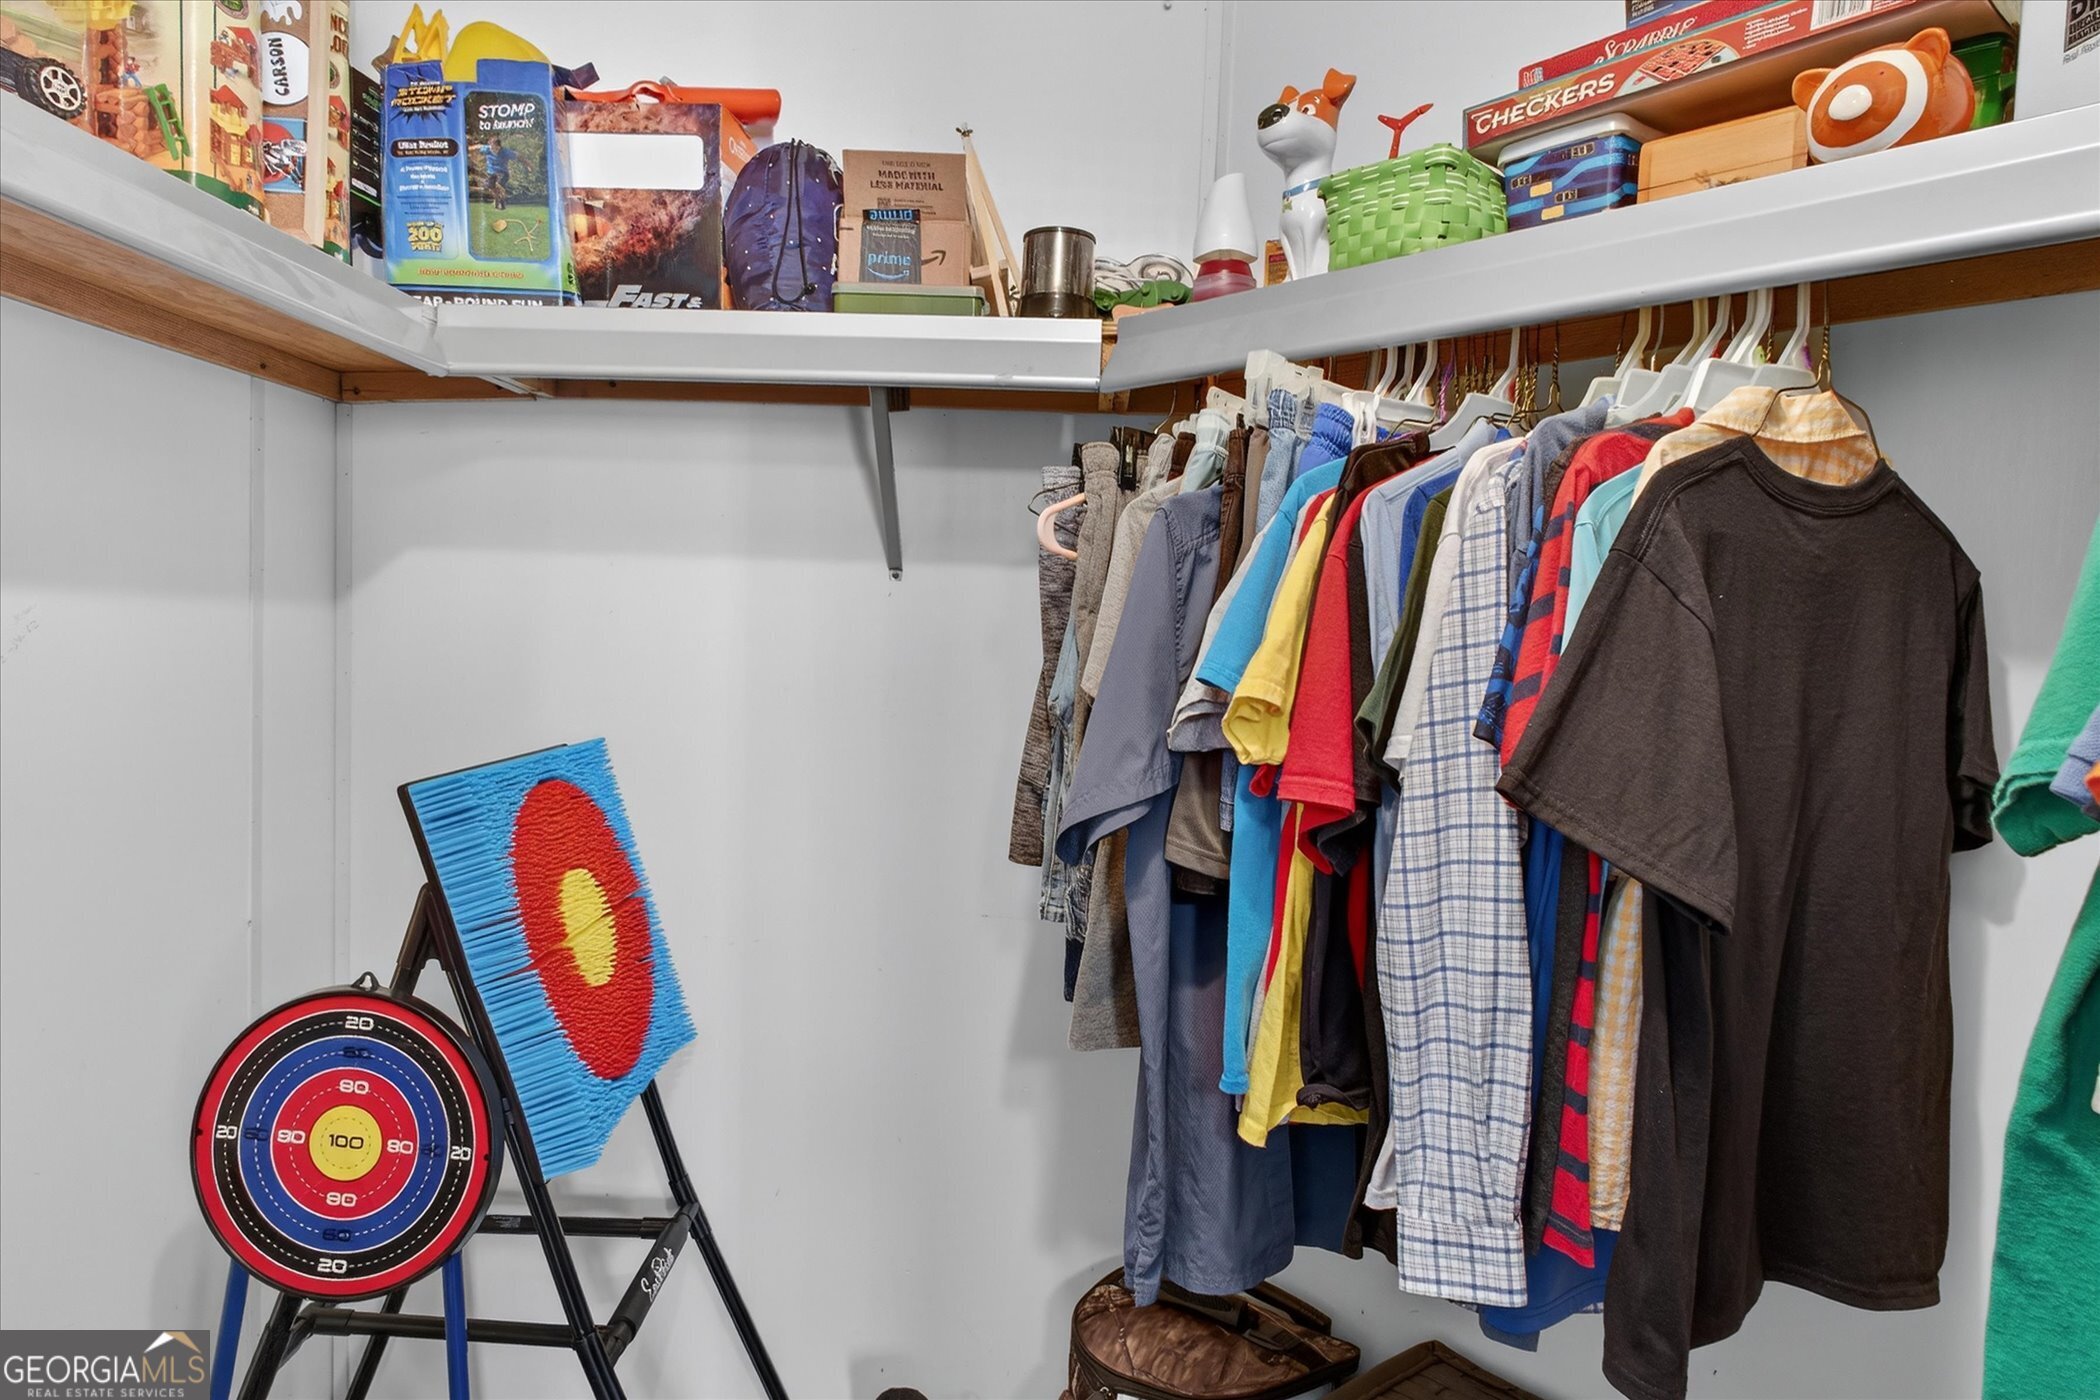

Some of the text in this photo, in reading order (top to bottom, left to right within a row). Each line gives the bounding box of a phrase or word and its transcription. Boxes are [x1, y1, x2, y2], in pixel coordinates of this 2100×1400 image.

[267, 37, 291, 97] CARSON
[478, 103, 536, 119] STOMP
[1473, 73, 1616, 134] CHECKERS
[408, 226, 443, 242] 200
[868, 251, 912, 266] prime
[607, 285, 690, 309] FAST
[345, 1016, 374, 1031] 20
[339, 1080, 369, 1095] 80
[216, 1125, 237, 1139] 20
[328, 1134, 364, 1150] 100
[387, 1139, 414, 1154] 80
[450, 1146, 472, 1161] 20
[317, 1258, 347, 1273] 20
